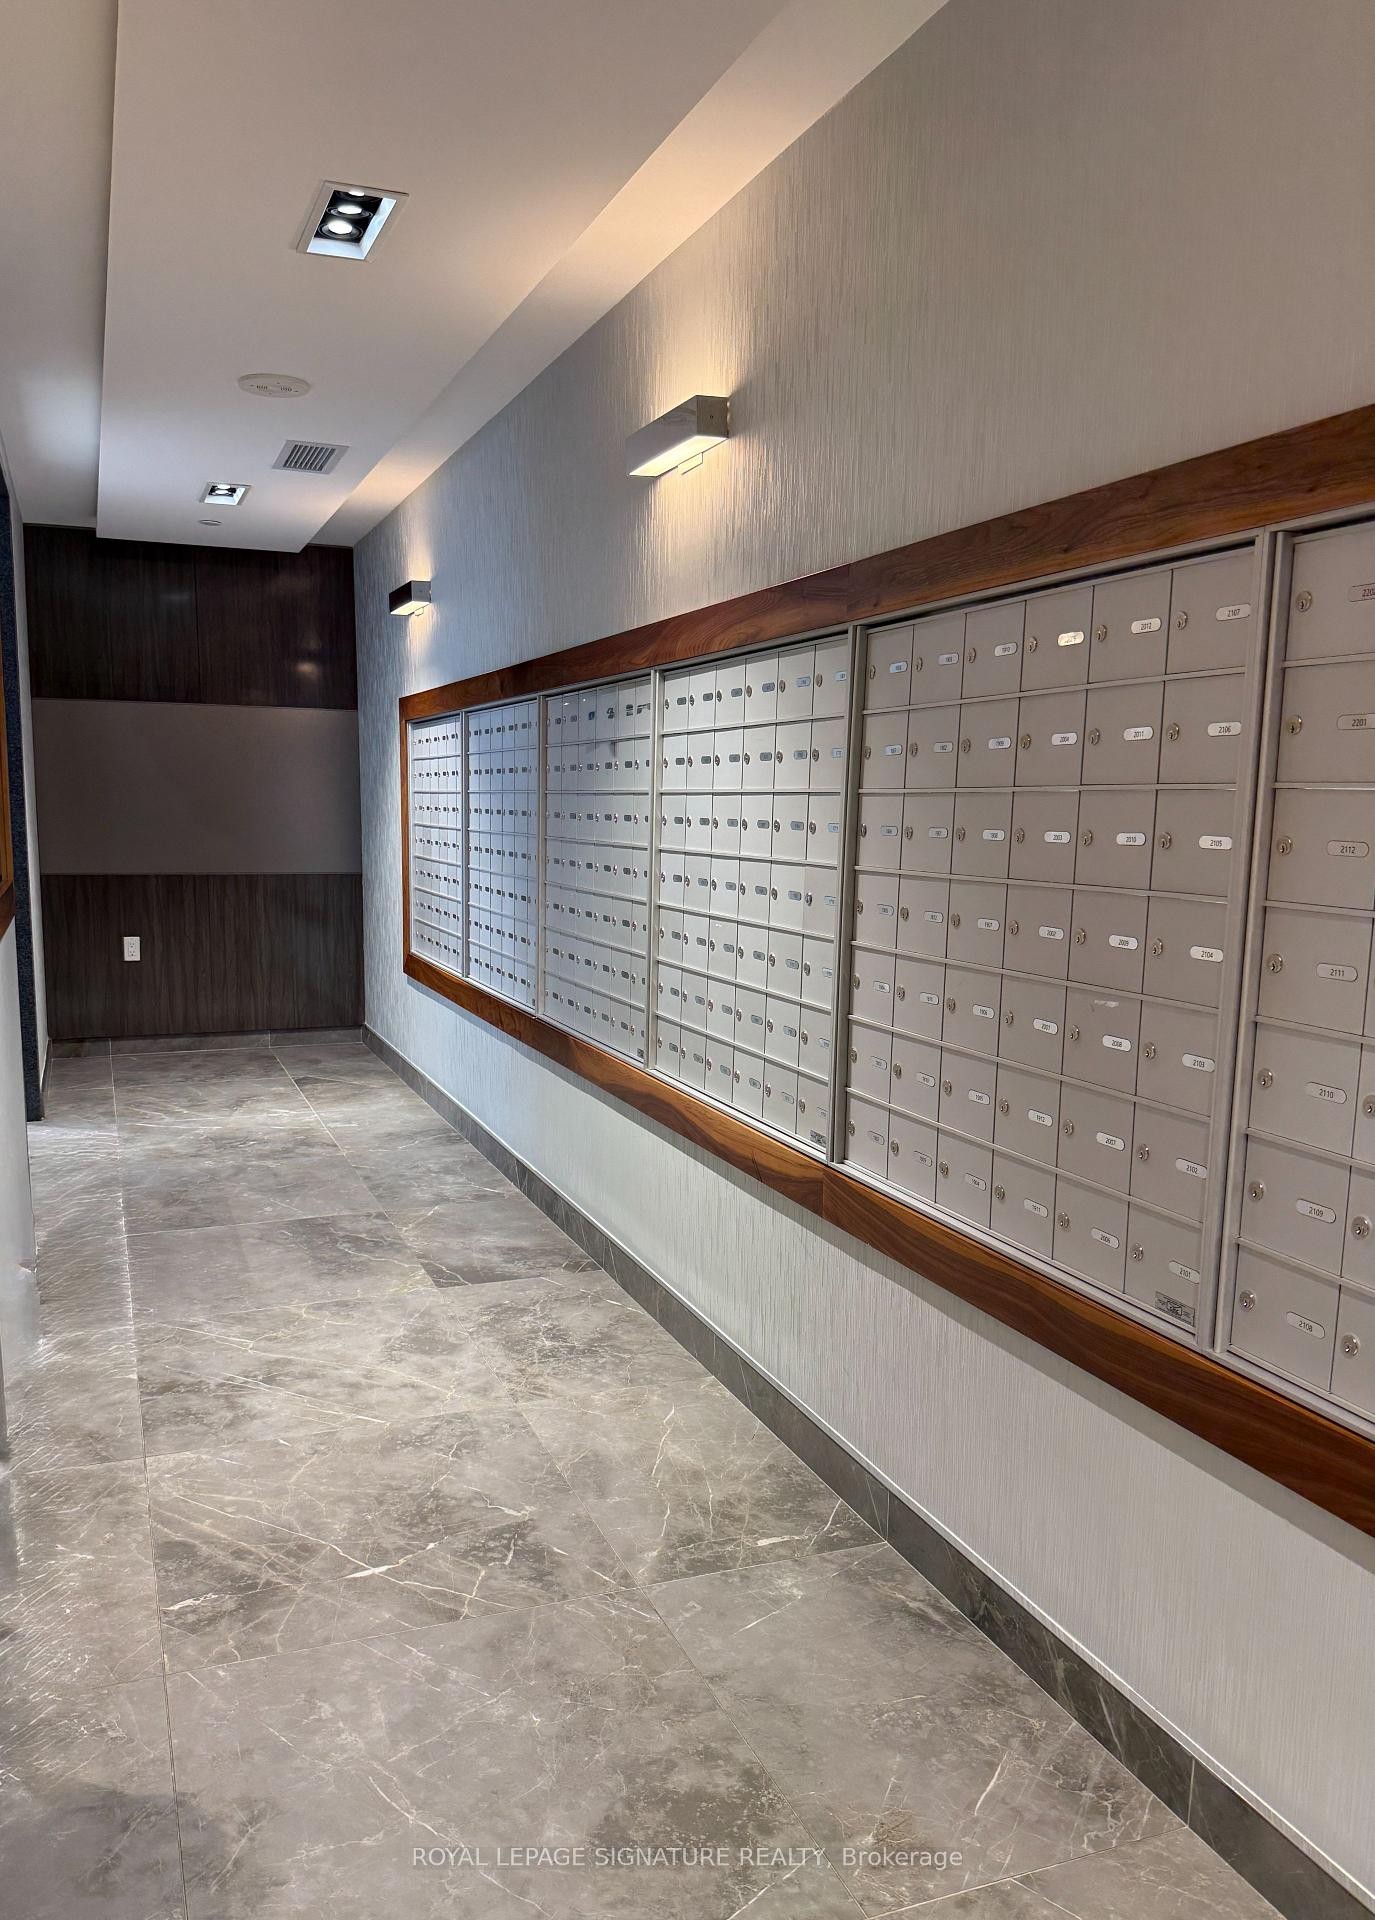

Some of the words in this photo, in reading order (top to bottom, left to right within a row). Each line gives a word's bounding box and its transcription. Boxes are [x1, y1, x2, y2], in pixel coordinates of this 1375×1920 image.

[1227, 608, 1241, 618] 2107
[1351, 718, 1367, 727] 2201
[1218, 725, 1232, 734] 2106
[1209, 839, 1223, 847] 2105
[1340, 845, 1356, 854] 2112
[1200, 950, 1214, 958] 2104
[1330, 968, 1345, 977] 2111
[1319, 1088, 1334, 1099] 2110
[1186, 1164, 1199, 1175] 2102
[1308, 1206, 1324, 1218] 2109
[1179, 1267, 1191, 1278] 2101
[1298, 1320, 1313, 1332] 2108
